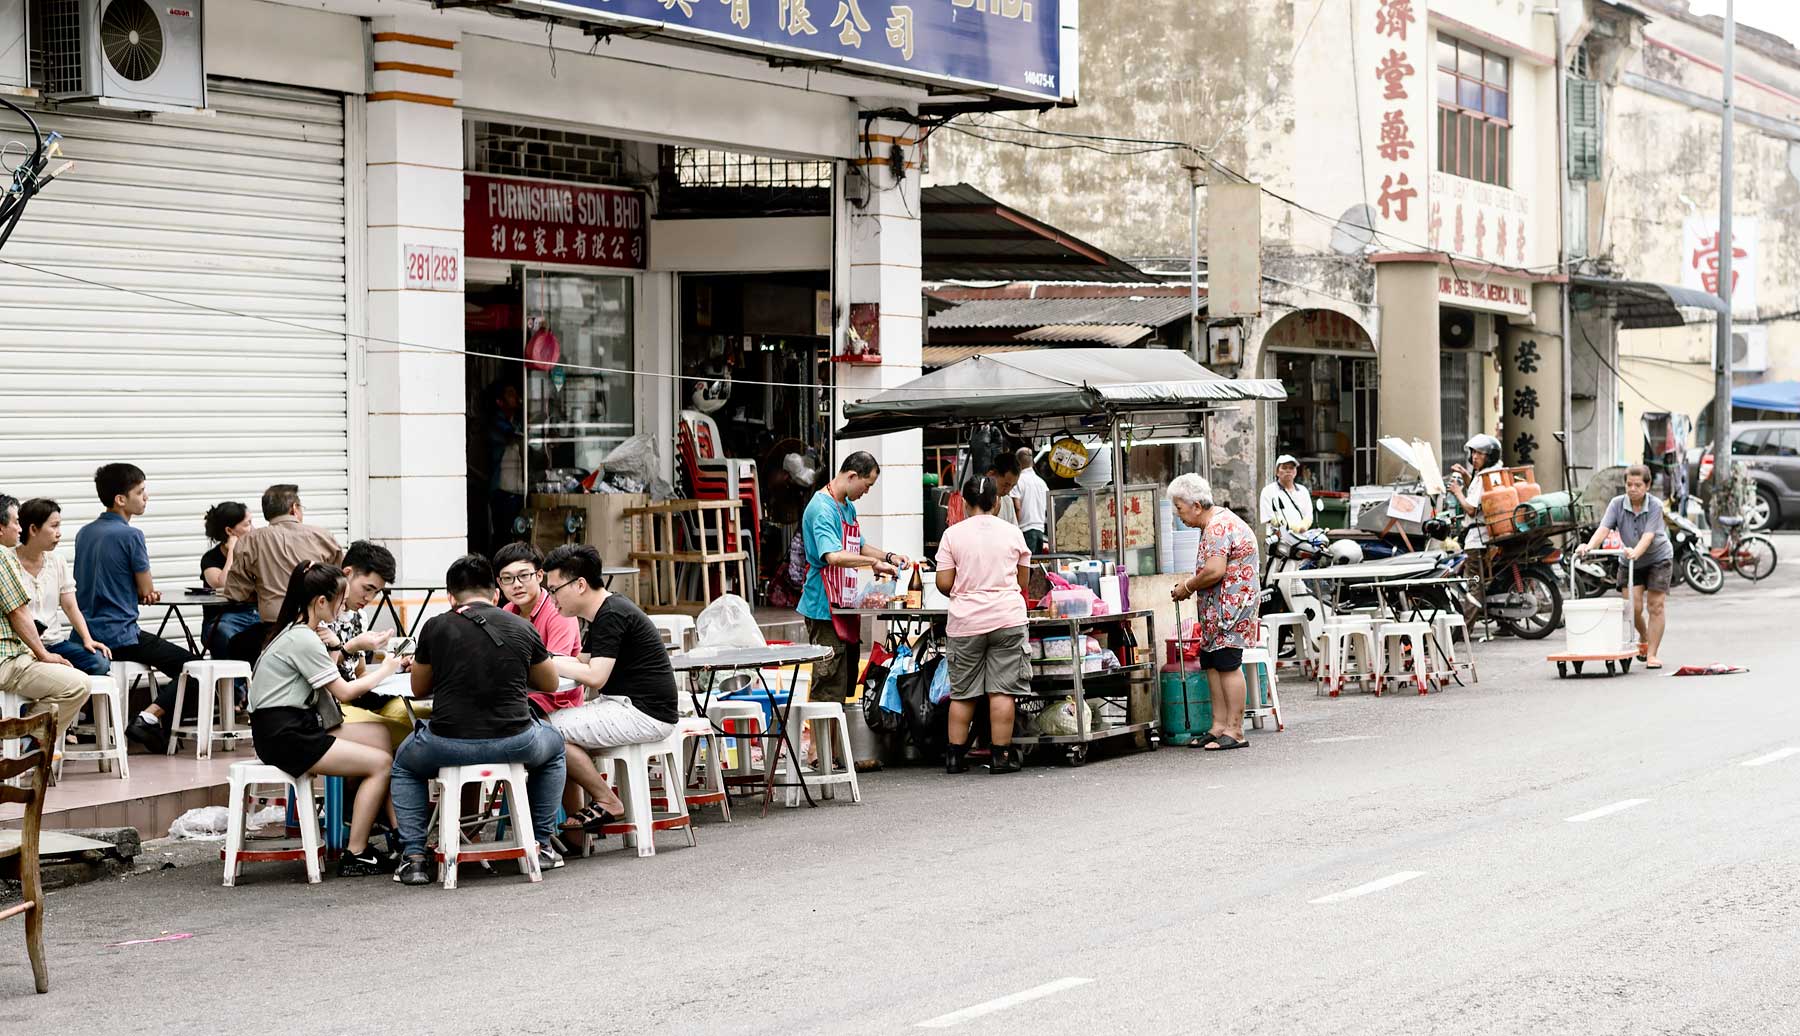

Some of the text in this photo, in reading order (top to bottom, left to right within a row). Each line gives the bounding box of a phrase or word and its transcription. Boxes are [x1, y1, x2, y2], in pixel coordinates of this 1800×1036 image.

[488, 183, 643, 230] FURNISHING SDN. BHD.
[409, 253, 430, 280] 281
[434, 255, 457, 281] 283
[1487, 283, 1511, 303] MEDICAL
[1513, 288, 1527, 305] HALL
